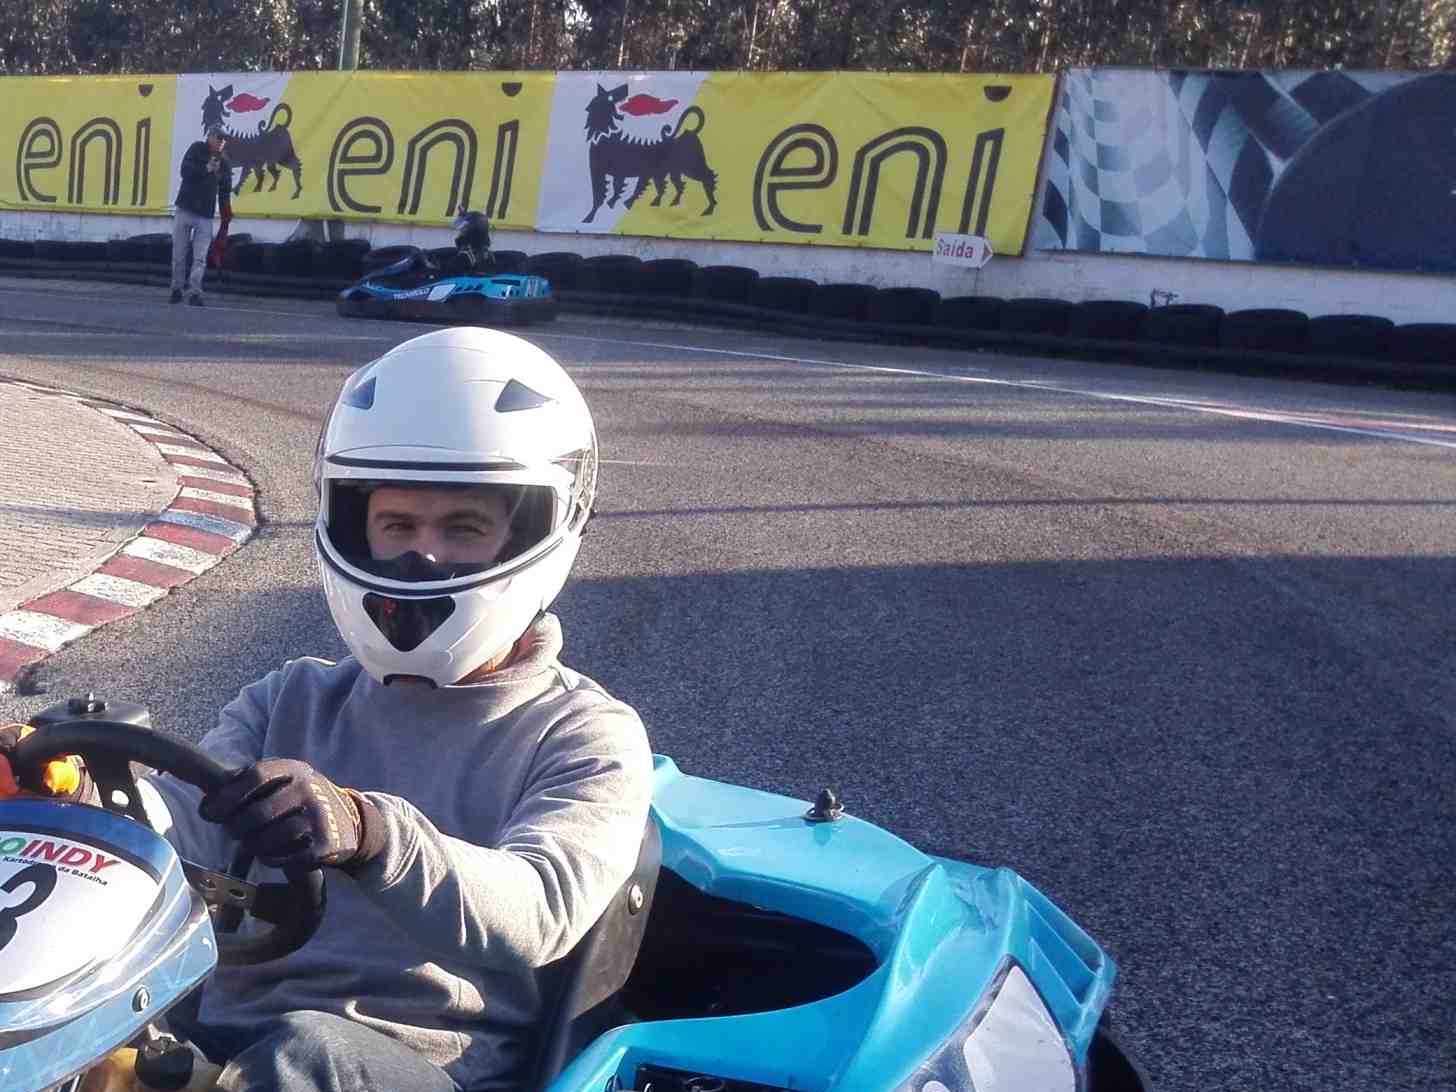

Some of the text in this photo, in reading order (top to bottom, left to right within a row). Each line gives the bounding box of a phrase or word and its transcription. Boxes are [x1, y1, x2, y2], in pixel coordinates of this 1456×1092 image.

[16, 84, 153, 205] eni
[327, 82, 522, 219] eni
[753, 86, 1012, 239] eni
